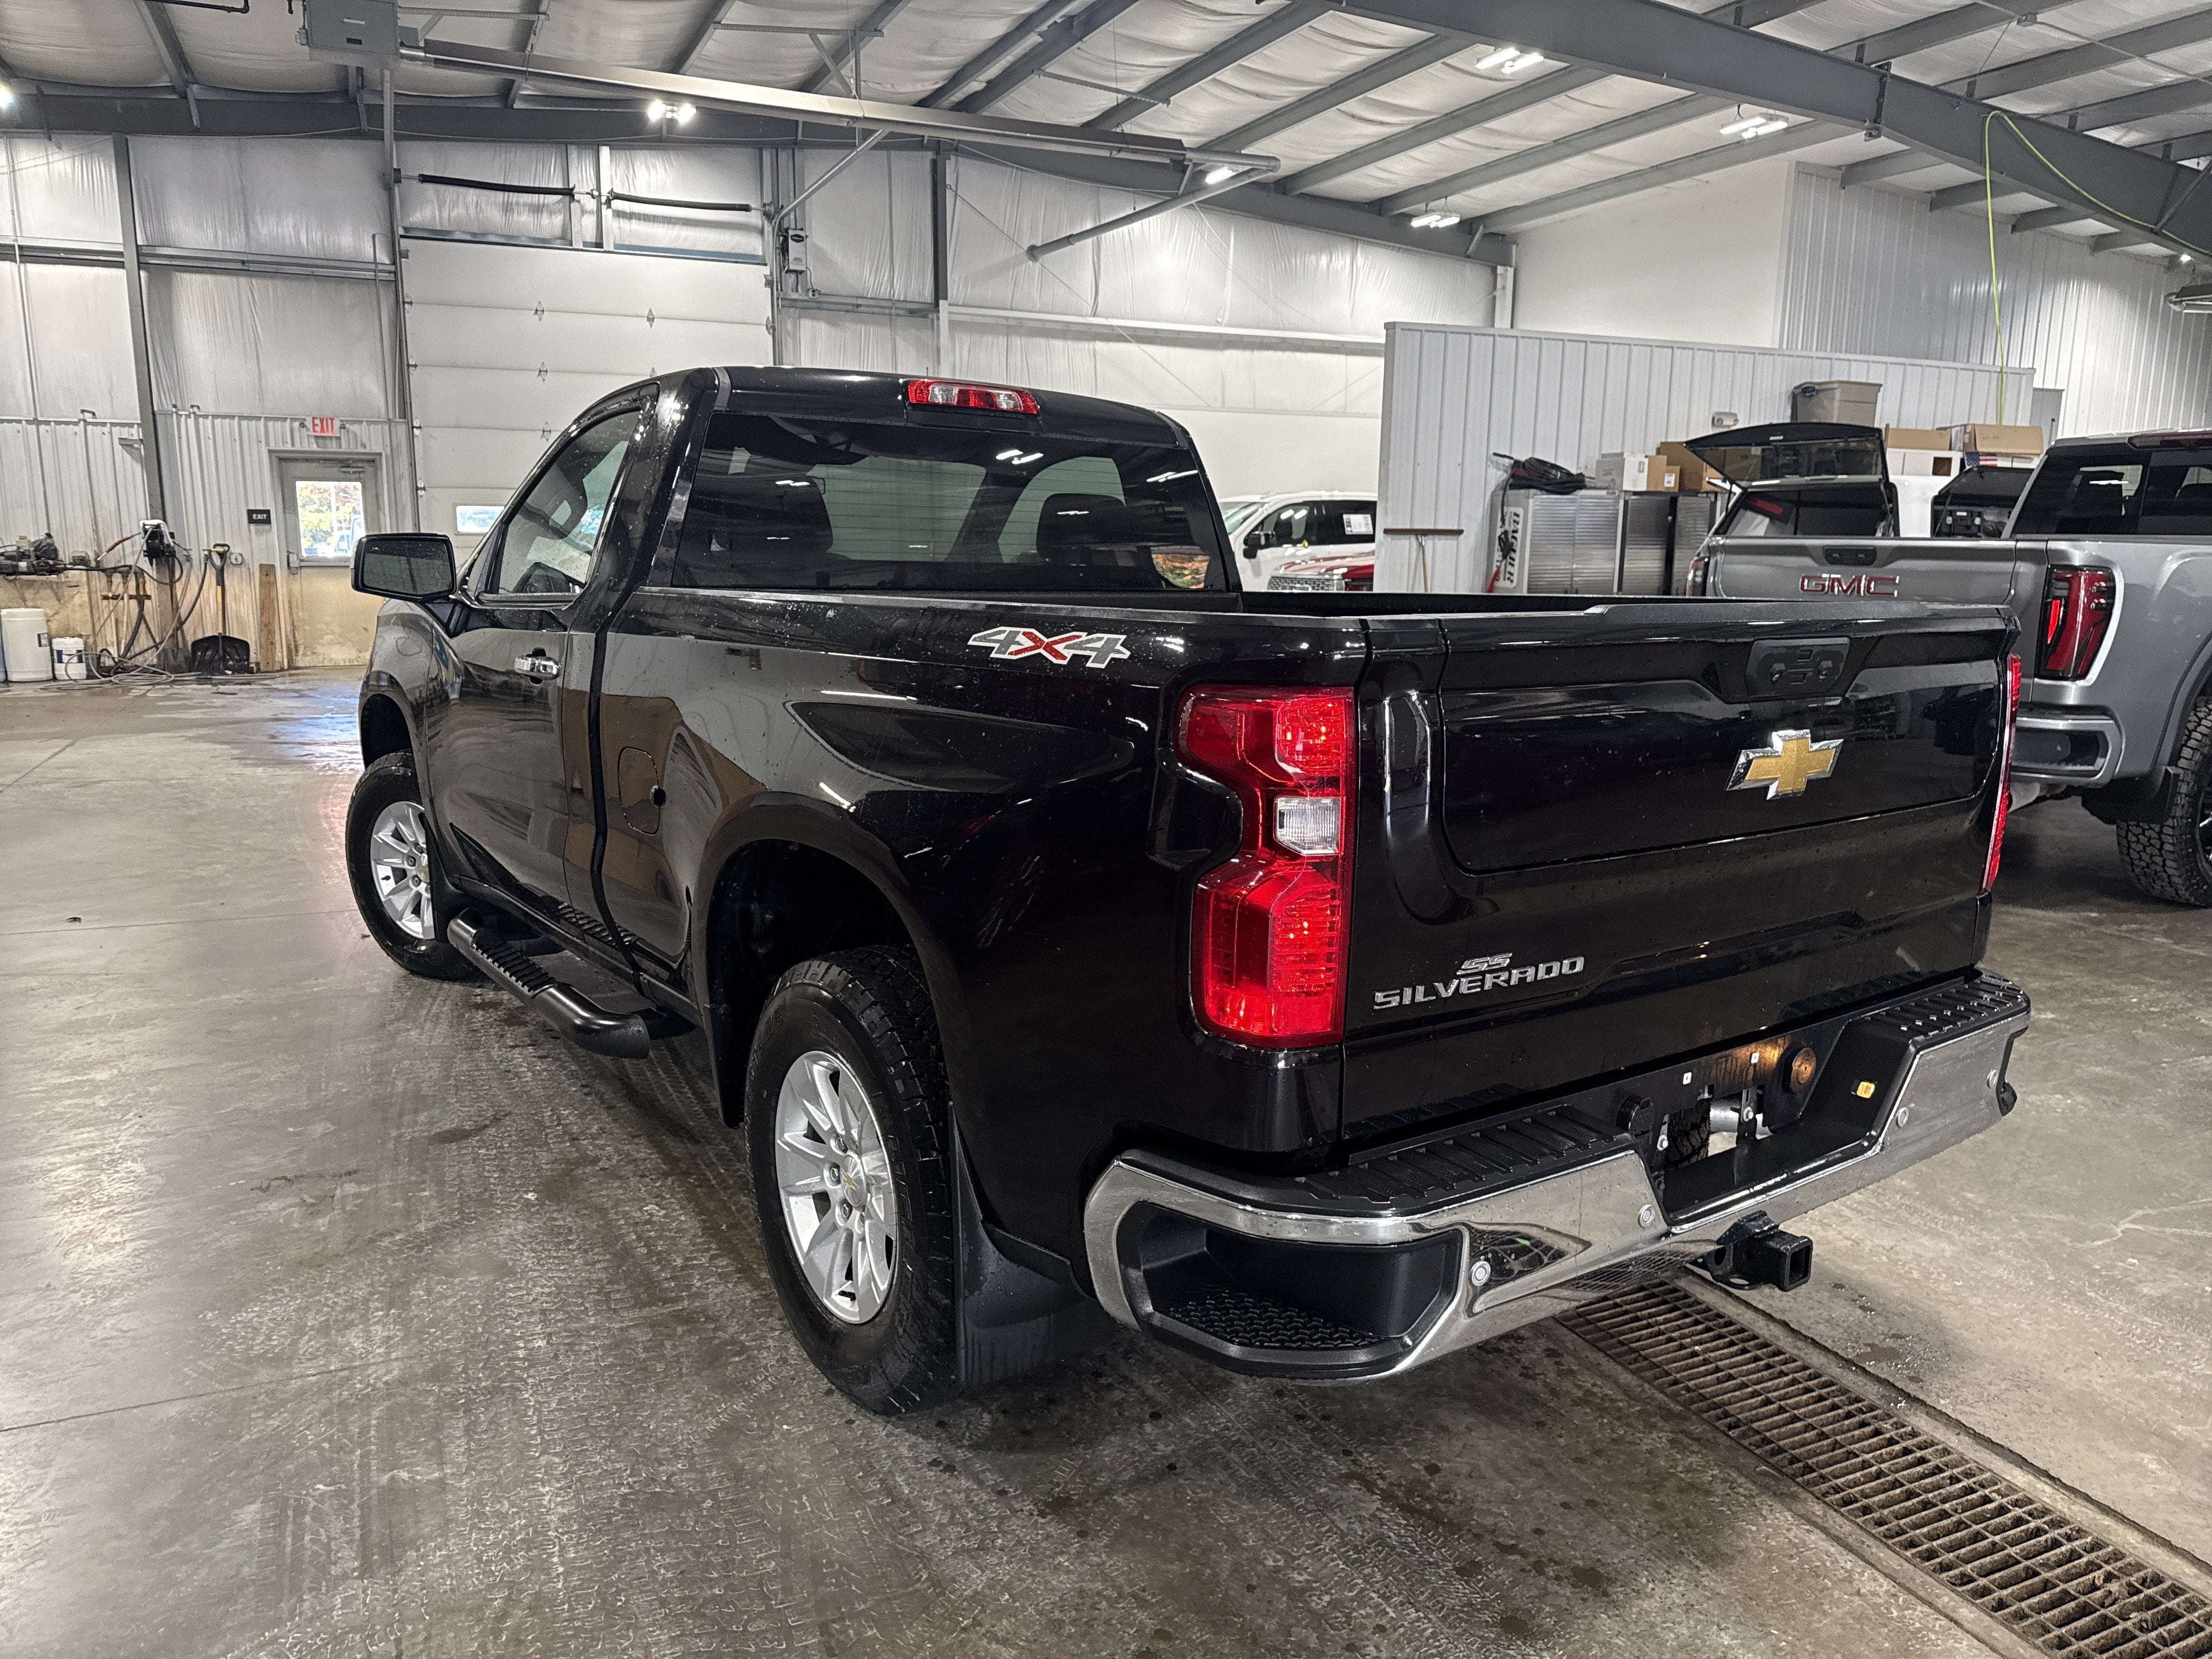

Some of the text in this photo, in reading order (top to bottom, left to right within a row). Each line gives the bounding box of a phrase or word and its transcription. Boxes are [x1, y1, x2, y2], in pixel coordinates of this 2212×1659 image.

[312, 416, 335, 434] EXIT
[1799, 573, 1900, 598] GMC
[1456, 952, 1513, 975] SS
[1373, 956, 1585, 1010] SILVERADO
